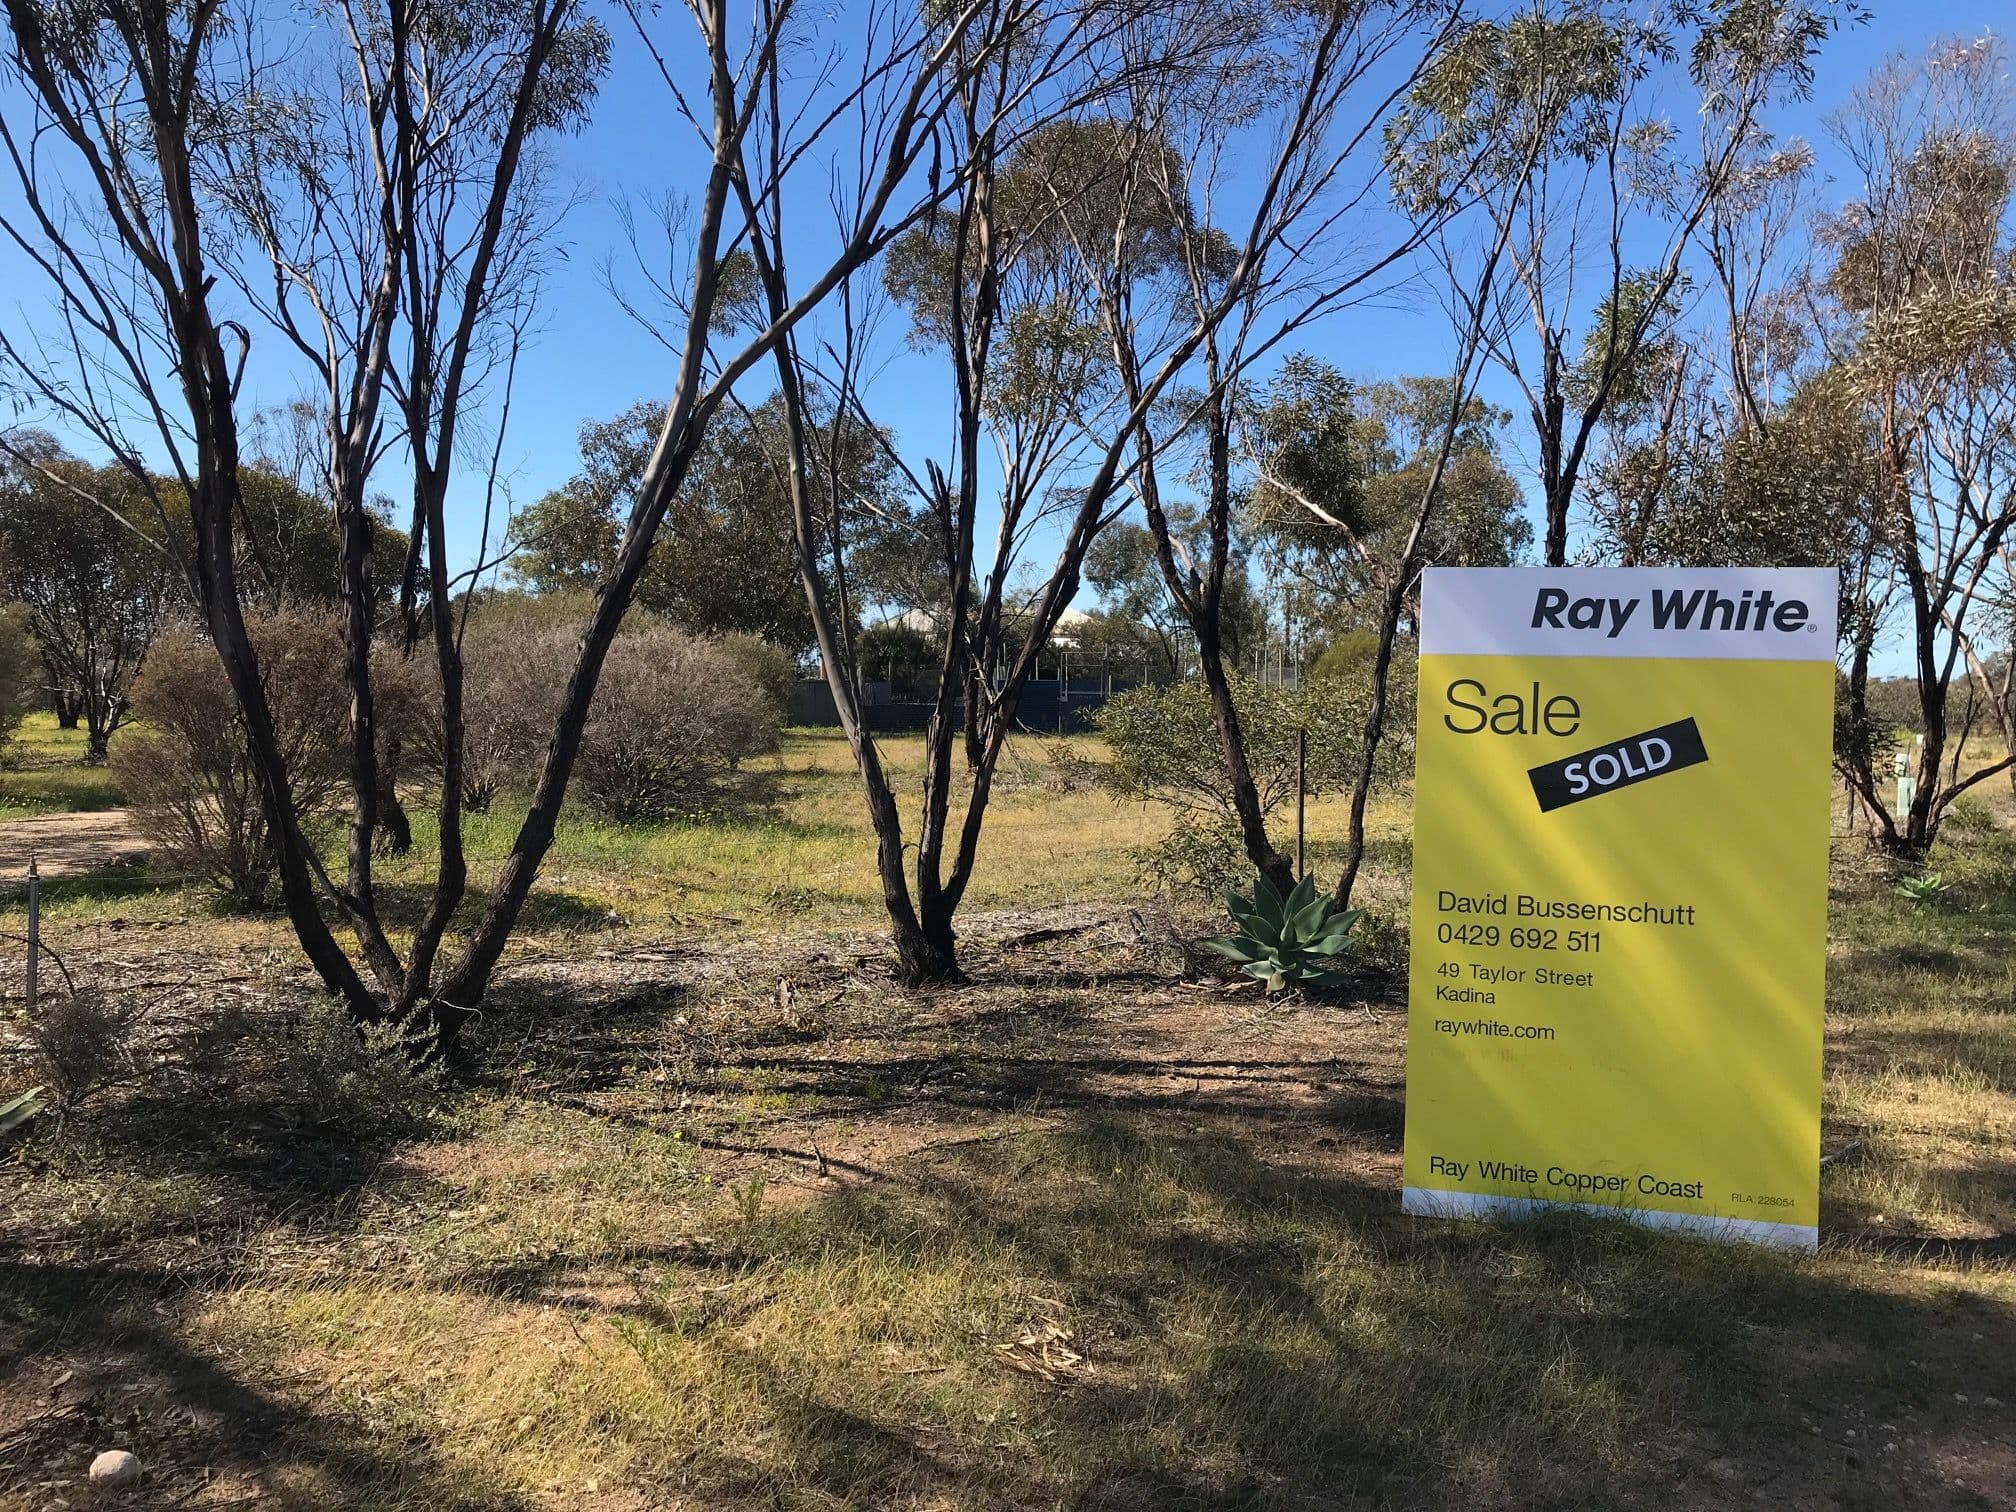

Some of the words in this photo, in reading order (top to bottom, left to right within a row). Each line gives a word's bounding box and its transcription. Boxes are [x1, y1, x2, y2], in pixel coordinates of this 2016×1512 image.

[1531, 587, 1639, 638] Ray
[1444, 679, 1581, 737] Sale
[1564, 737, 1672, 794] SOLD
[1438, 890, 1507, 916] David
[1516, 896, 1695, 926] Bussenschutt
[1437, 923, 1500, 947] 0429
[1510, 927, 1557, 950] 692
[1566, 930, 1601, 953] 511
[1437, 962, 1460, 978] 49
[1469, 964, 1525, 984] Taylor
[1534, 968, 1593, 986] Street
[1436, 986, 1496, 1004] Kadina
[1434, 1018, 1555, 1040] raywhite.com
[1429, 1156, 1469, 1180] Ray
[1478, 1160, 1538, 1184] White
[1546, 1166, 1629, 1193] Copper
[1637, 1175, 1703, 1199] Coast
[1731, 1192, 1753, 1204] RLA
